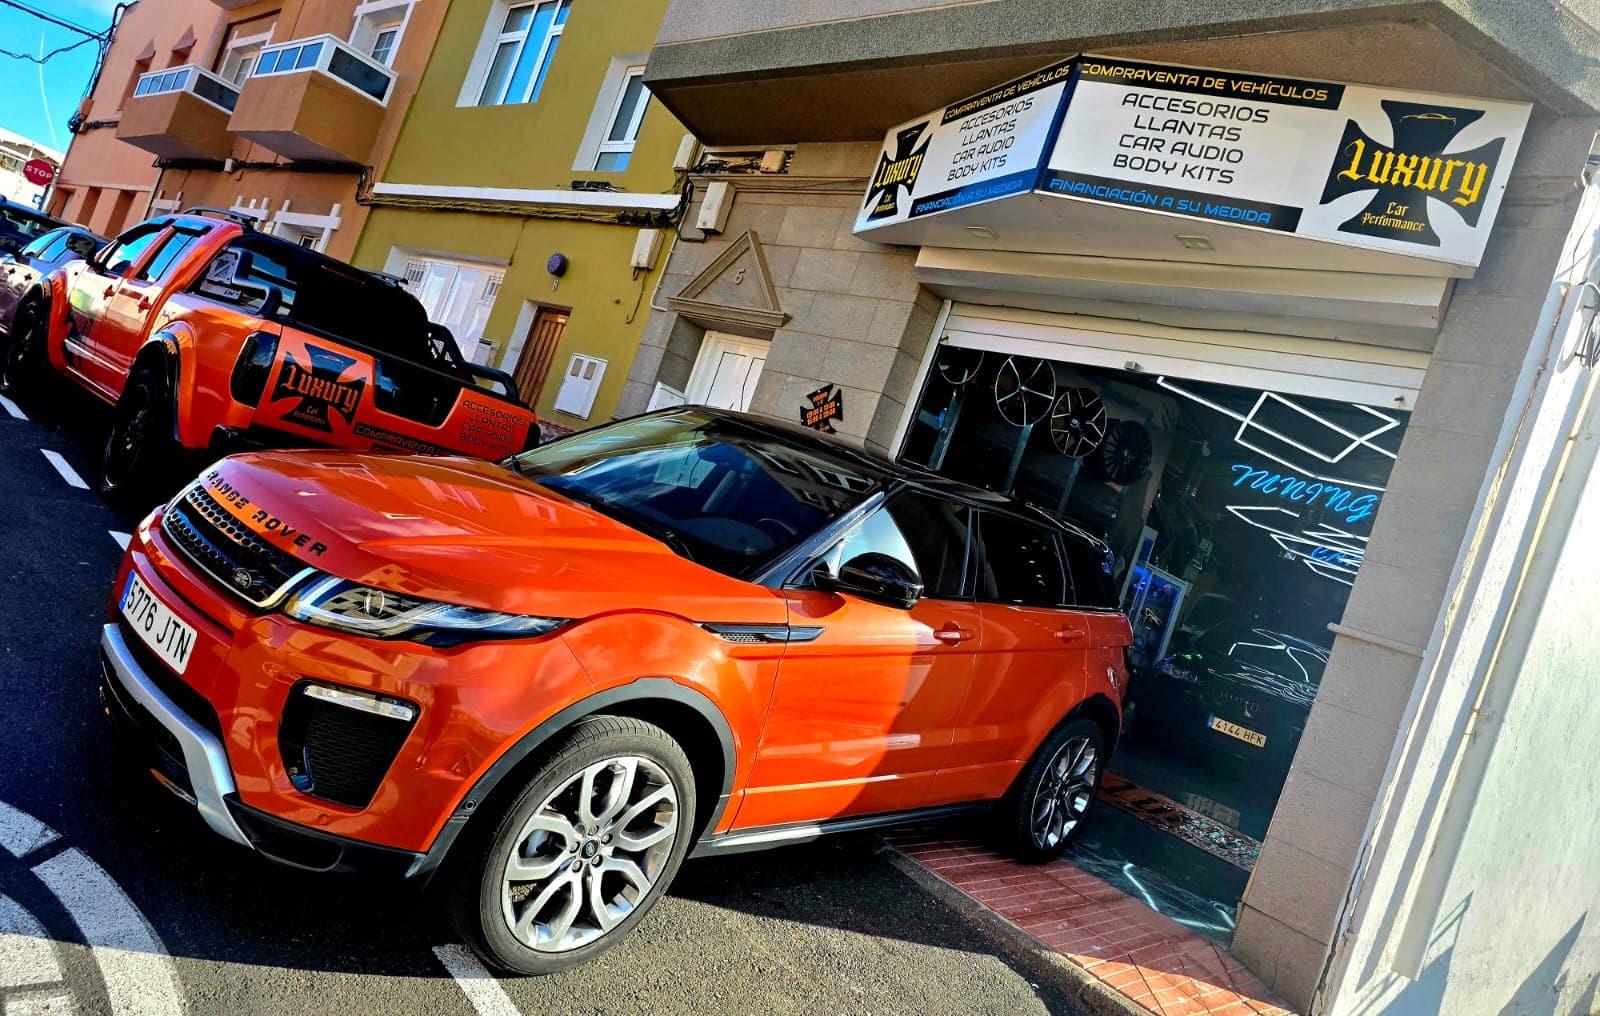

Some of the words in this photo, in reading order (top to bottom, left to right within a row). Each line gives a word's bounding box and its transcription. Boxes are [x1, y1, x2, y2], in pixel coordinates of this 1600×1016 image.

[1080, 63, 1199, 87] COMPRAVENTA
[1202, 77, 1226, 90] DE
[1230, 80, 1329, 101] VEHÍCULOS
[944, 91, 1003, 119] COMPRAVENTA
[1003, 85, 1017, 97] DE
[959, 97, 1034, 133] ACCESORIOS
[1122, 93, 1270, 123] ACCESORIOS
[962, 119, 1016, 147] LLANTAS
[1133, 114, 1242, 142] LLANTAS
[952, 148, 976, 164] CAR
[977, 136, 1015, 157] AUDIO
[1118, 134, 1165, 152] CAR
[1170, 142, 1244, 164] AUDIO
[25, 164, 52, 178] STOP
[947, 162, 979, 181] BODY
[980, 154, 1007, 172] KITS
[1112, 154, 1178, 176] BODY
[1181, 164, 1235, 184] KITS
[1337, 139, 1489, 207] Luxury
[975, 188, 987, 200] SU
[987, 179, 1024, 198] MEDIDA
[1050, 178, 1157, 207] FINANCIACIÓN
[1160, 192, 1174, 208] A
[1177, 199, 1200, 213] SU
[1203, 203, 1272, 224] MEDIDA
[1362, 213, 1425, 232] Performance
[1386, 202, 1409, 216] Car
[280, 365, 358, 413] Luxury
[463, 400, 525, 425] ACCESORIOS
[469, 412, 514, 433] LLANTAS
[462, 422, 483, 434] CAR
[207, 470, 250, 509] RANGE
[251, 510, 328, 557] ROVER
[127, 579, 158, 632] 5776
[156, 616, 192, 663] JTN
[1214, 720, 1240, 736] 4144
[1243, 732, 1264, 745] HFK
